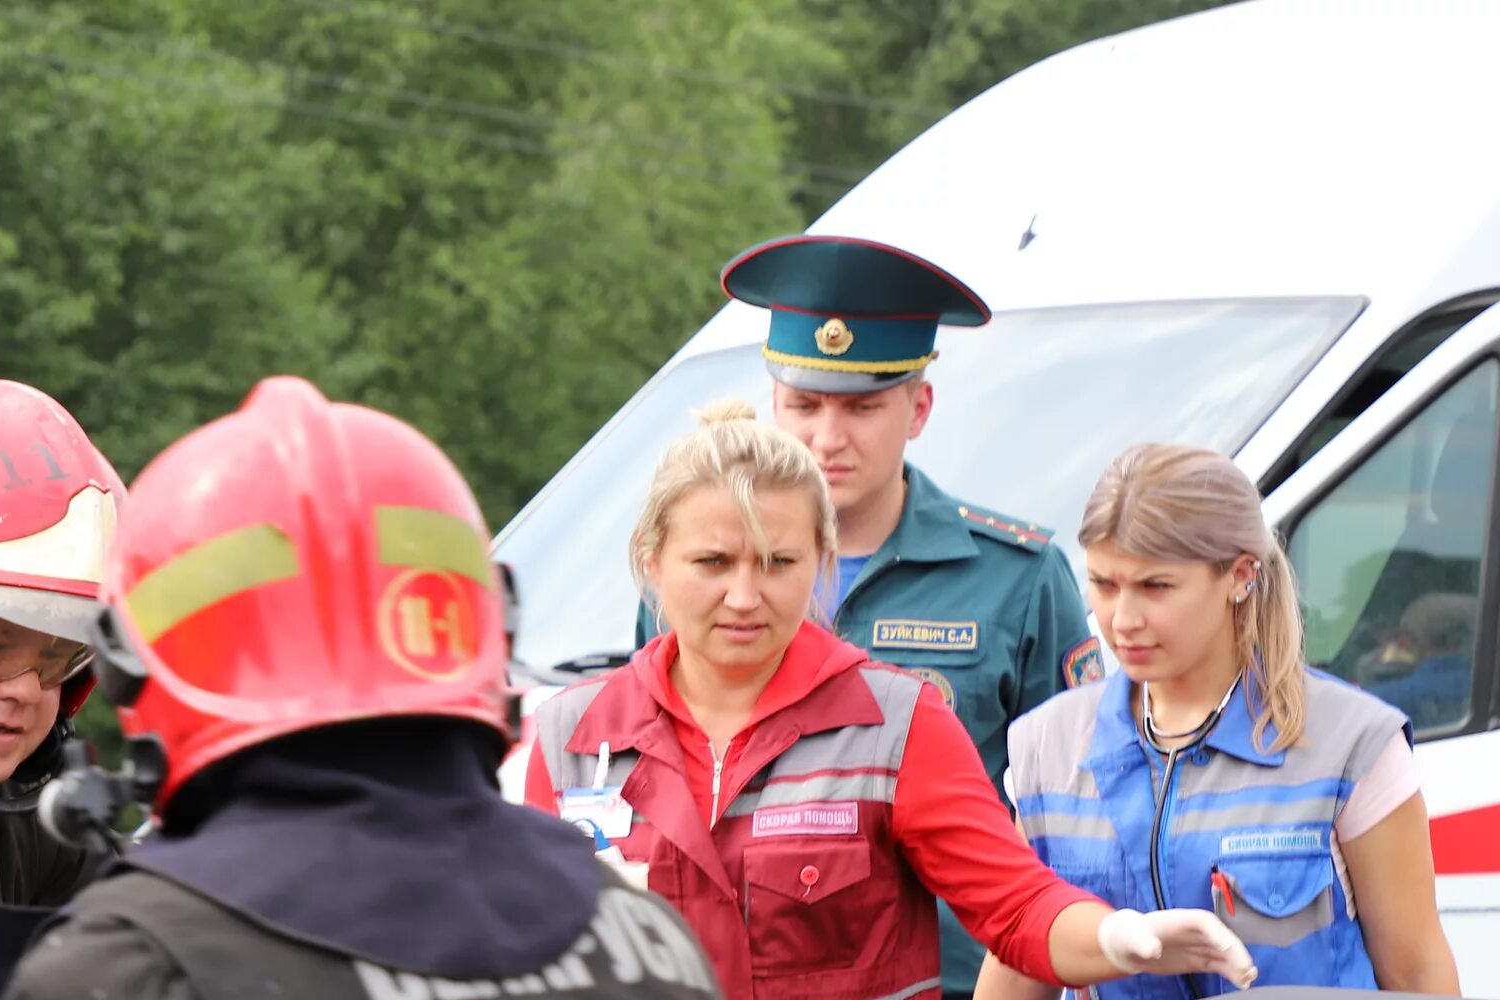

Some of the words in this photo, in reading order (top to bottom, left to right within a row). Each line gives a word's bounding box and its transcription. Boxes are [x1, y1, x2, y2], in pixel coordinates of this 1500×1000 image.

[881, 625, 945, 643] ЗУЙКЕВИЧ
[760, 813, 801, 829] СКОРАЯ
[804, 810, 853, 827] ПОМОЩЬ
[1228, 836, 1269, 850] СКОРАЯ
[1272, 834, 1318, 848] ПОМОЩЬ
